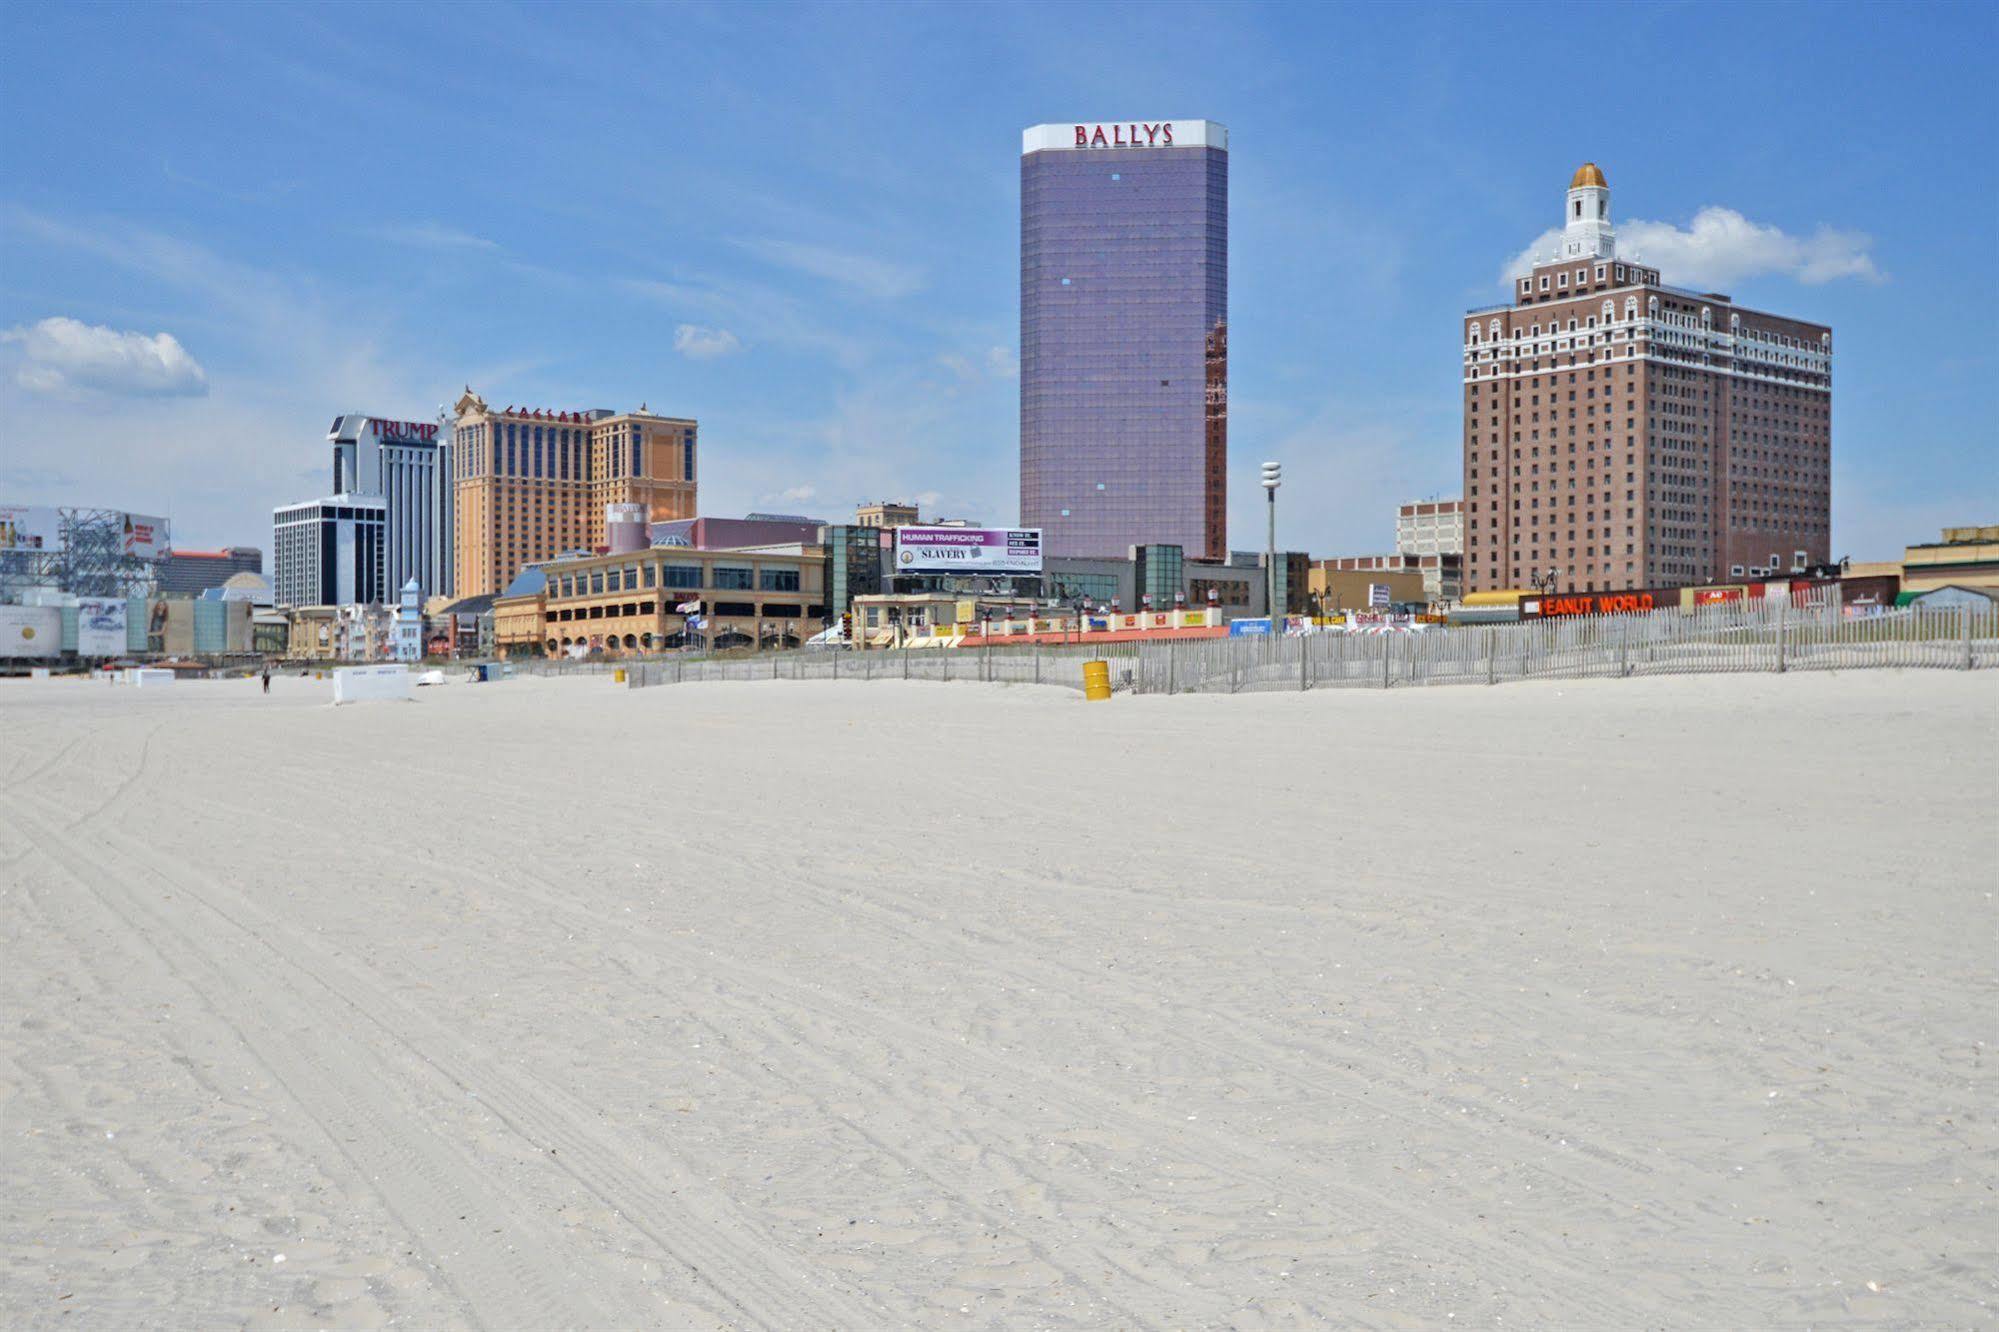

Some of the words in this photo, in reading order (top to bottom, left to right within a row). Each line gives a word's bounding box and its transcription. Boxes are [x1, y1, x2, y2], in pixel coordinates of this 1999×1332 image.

[1074, 123, 1174, 146] BALLYS
[505, 404, 593, 425] CAESARS
[368, 418, 439, 441] TRUMP
[902, 533, 934, 541] HUMAN
[935, 534, 984, 542] TRAFFICKING
[921, 550, 967, 559] SLAVERY
[1599, 593, 1653, 612] WORLD
